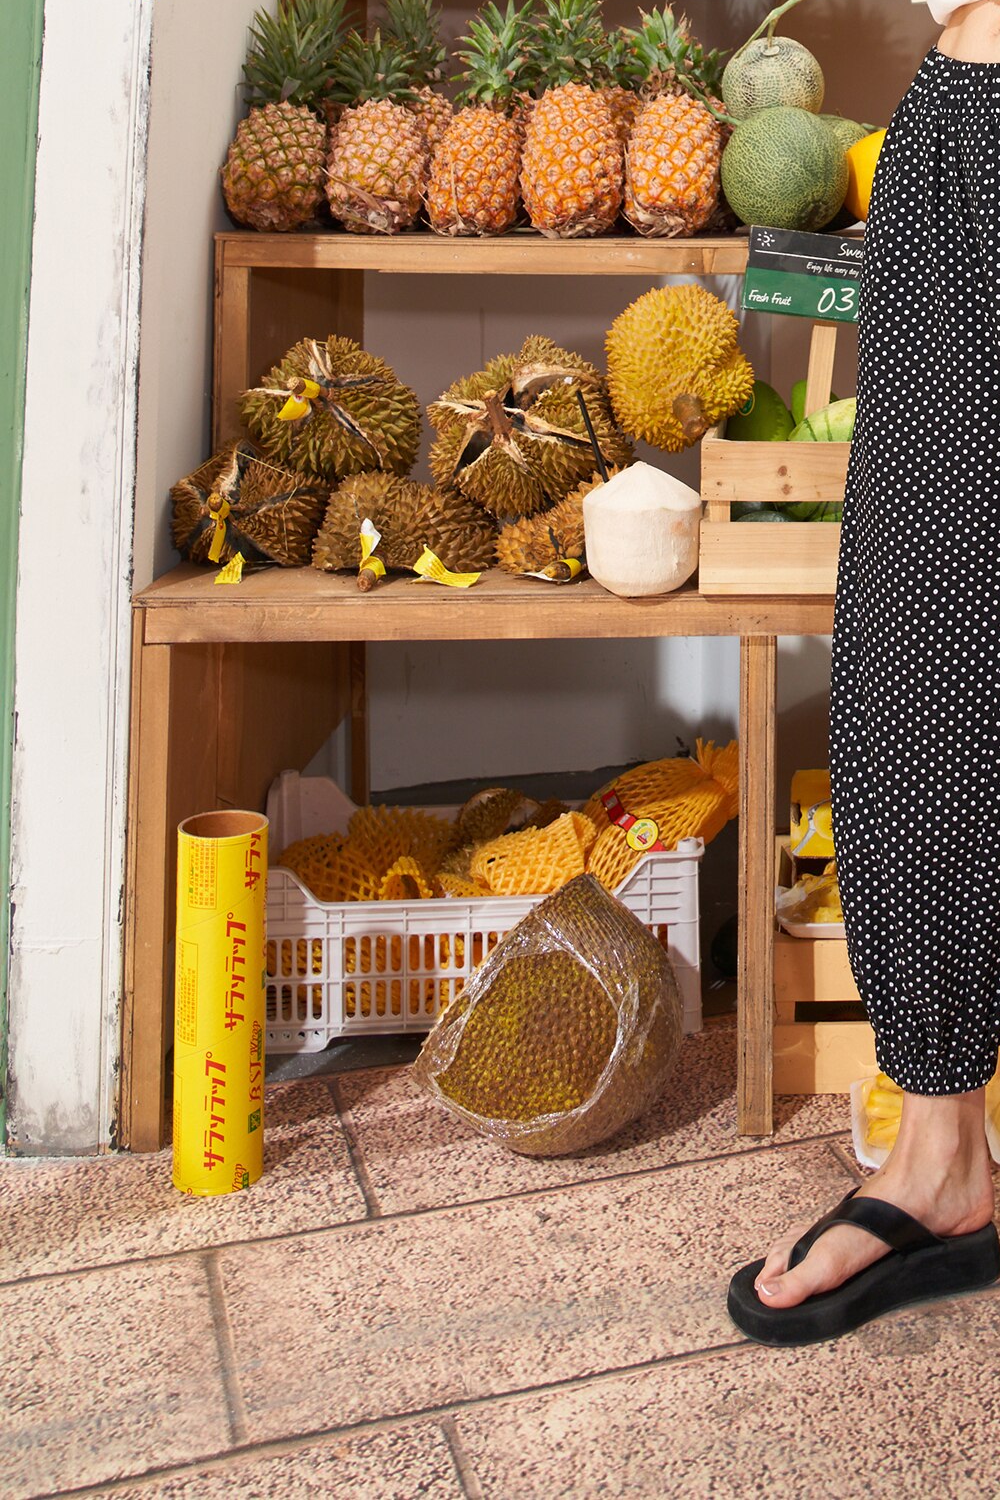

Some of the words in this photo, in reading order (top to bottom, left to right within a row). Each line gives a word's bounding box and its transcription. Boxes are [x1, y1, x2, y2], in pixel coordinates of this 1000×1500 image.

[806, 261, 822, 274] Enjoy
[824, 263, 834, 273] life
[748, 289, 769, 303] Fresh
[771, 292, 792, 306] Fruit
